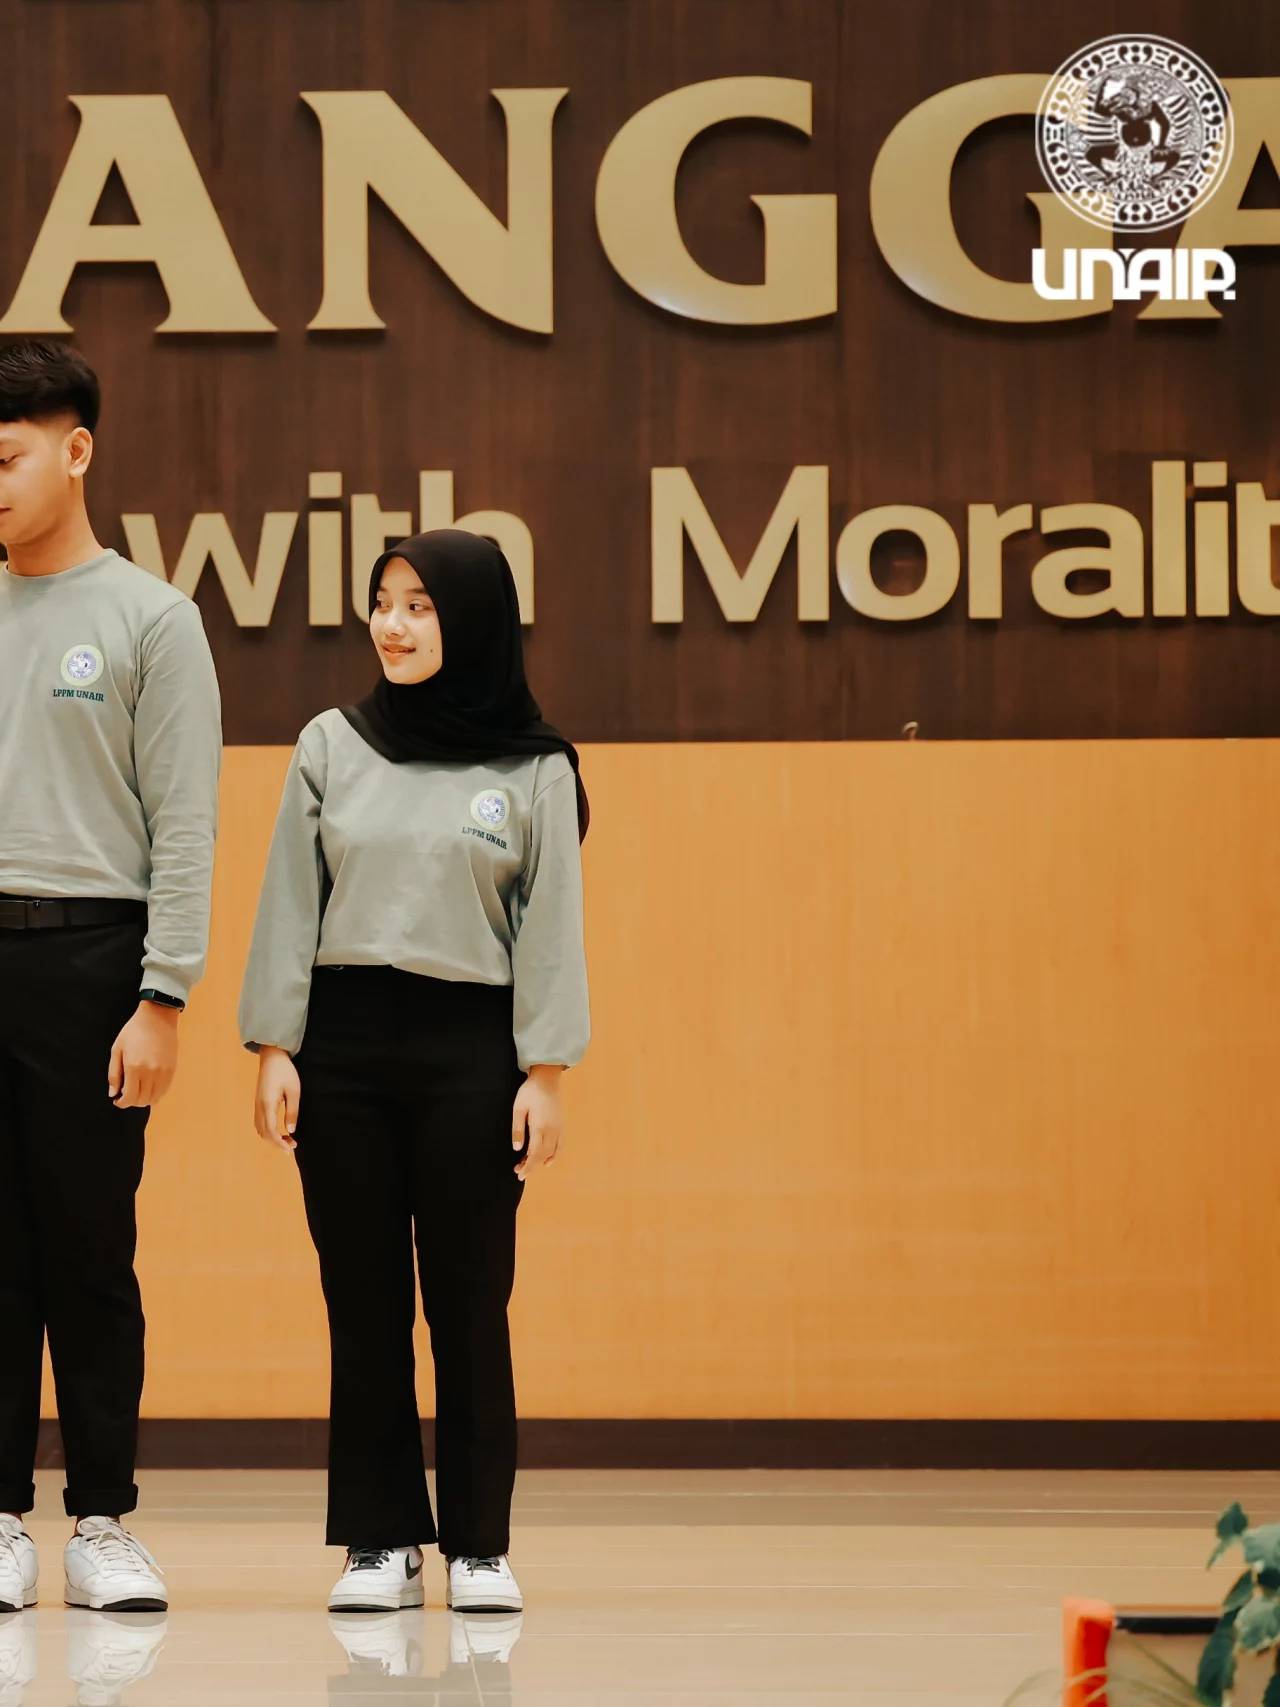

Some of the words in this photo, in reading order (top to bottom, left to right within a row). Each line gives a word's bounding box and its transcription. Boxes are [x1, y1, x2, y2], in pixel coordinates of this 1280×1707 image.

[120, 470, 535, 627] with
[53, 689, 75, 698] LPPM
[76, 690, 105, 702] UNAIR
[462, 826, 485, 839] LPPM
[485, 833, 508, 850] UNAIR
